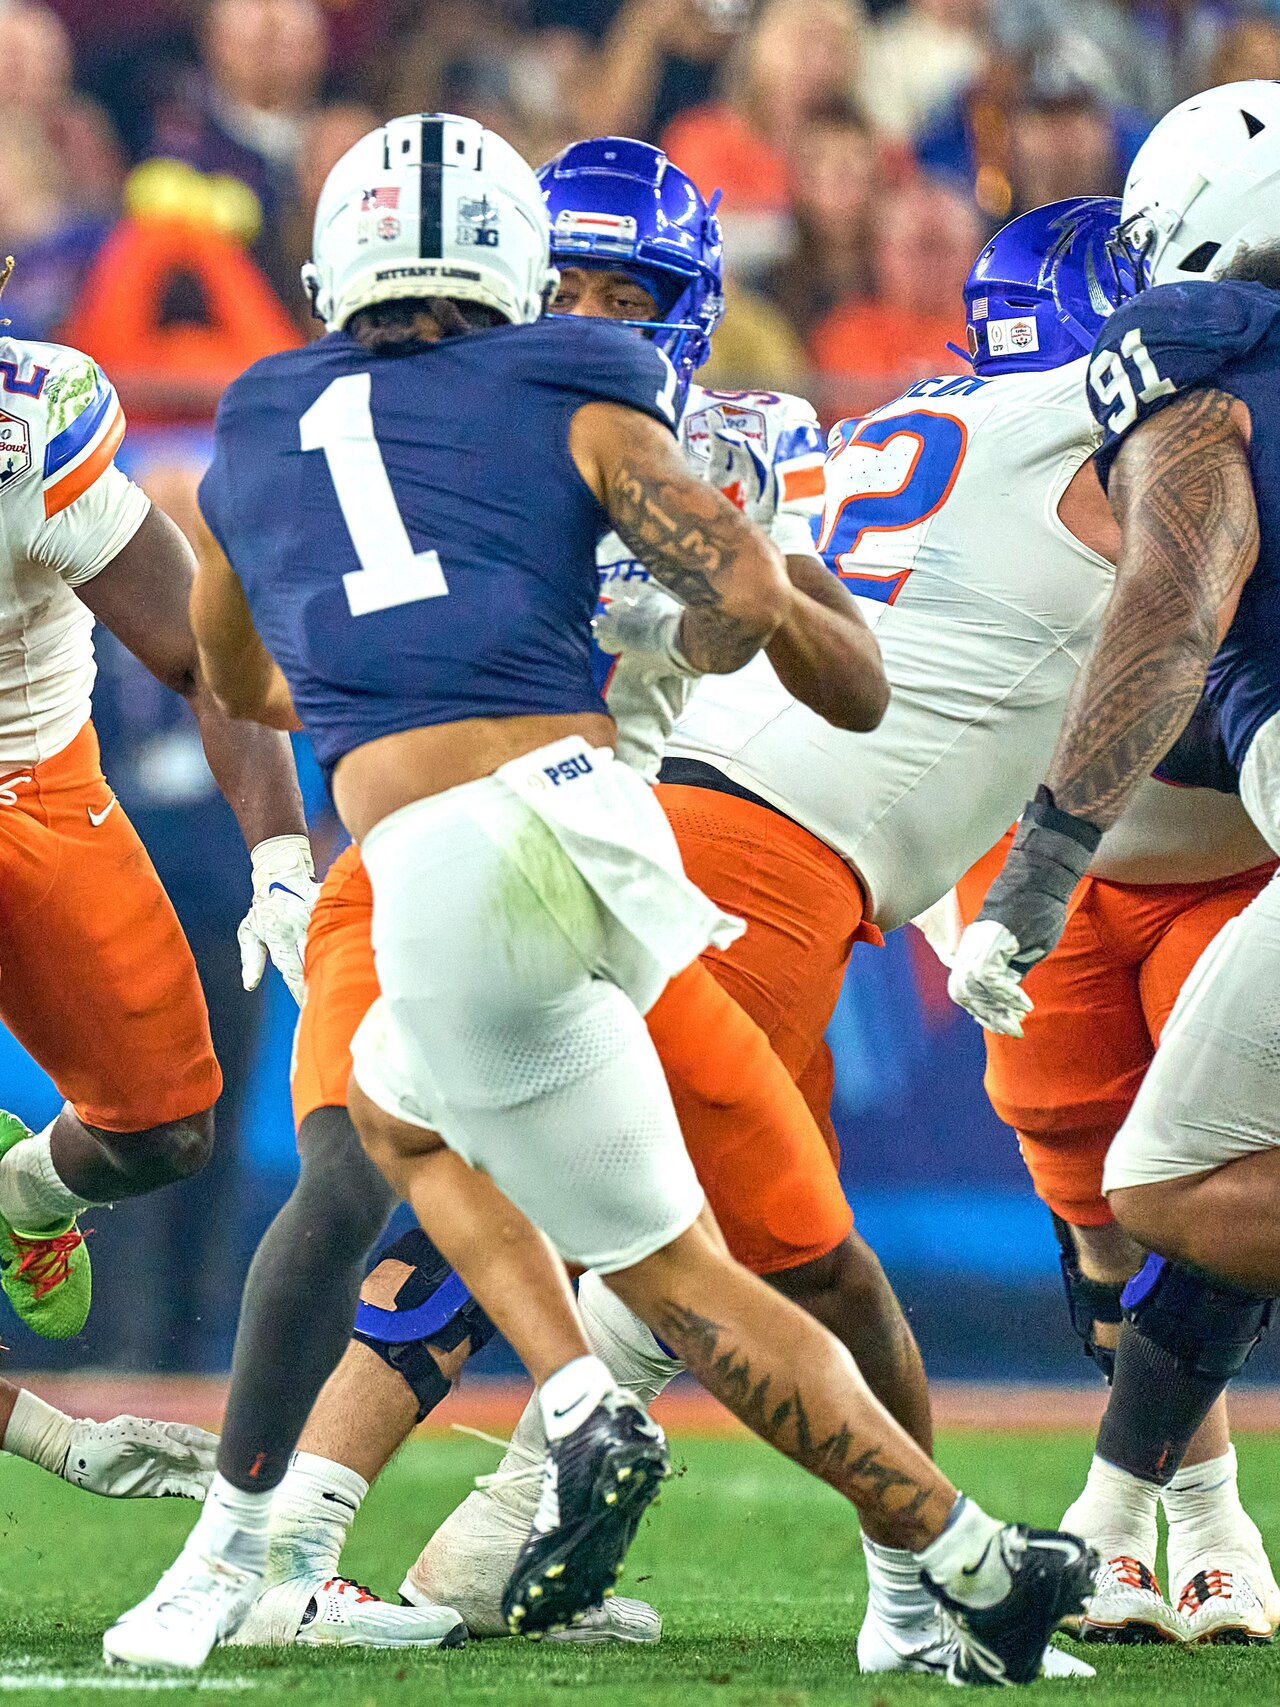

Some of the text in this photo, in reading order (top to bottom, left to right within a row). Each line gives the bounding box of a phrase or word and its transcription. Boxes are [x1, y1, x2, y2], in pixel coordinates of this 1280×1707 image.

[375, 266, 437, 281] NITTANY
[1089, 328, 1177, 434] 91
[299, 372, 449, 617] 1
[543, 752, 594, 786] PSU
